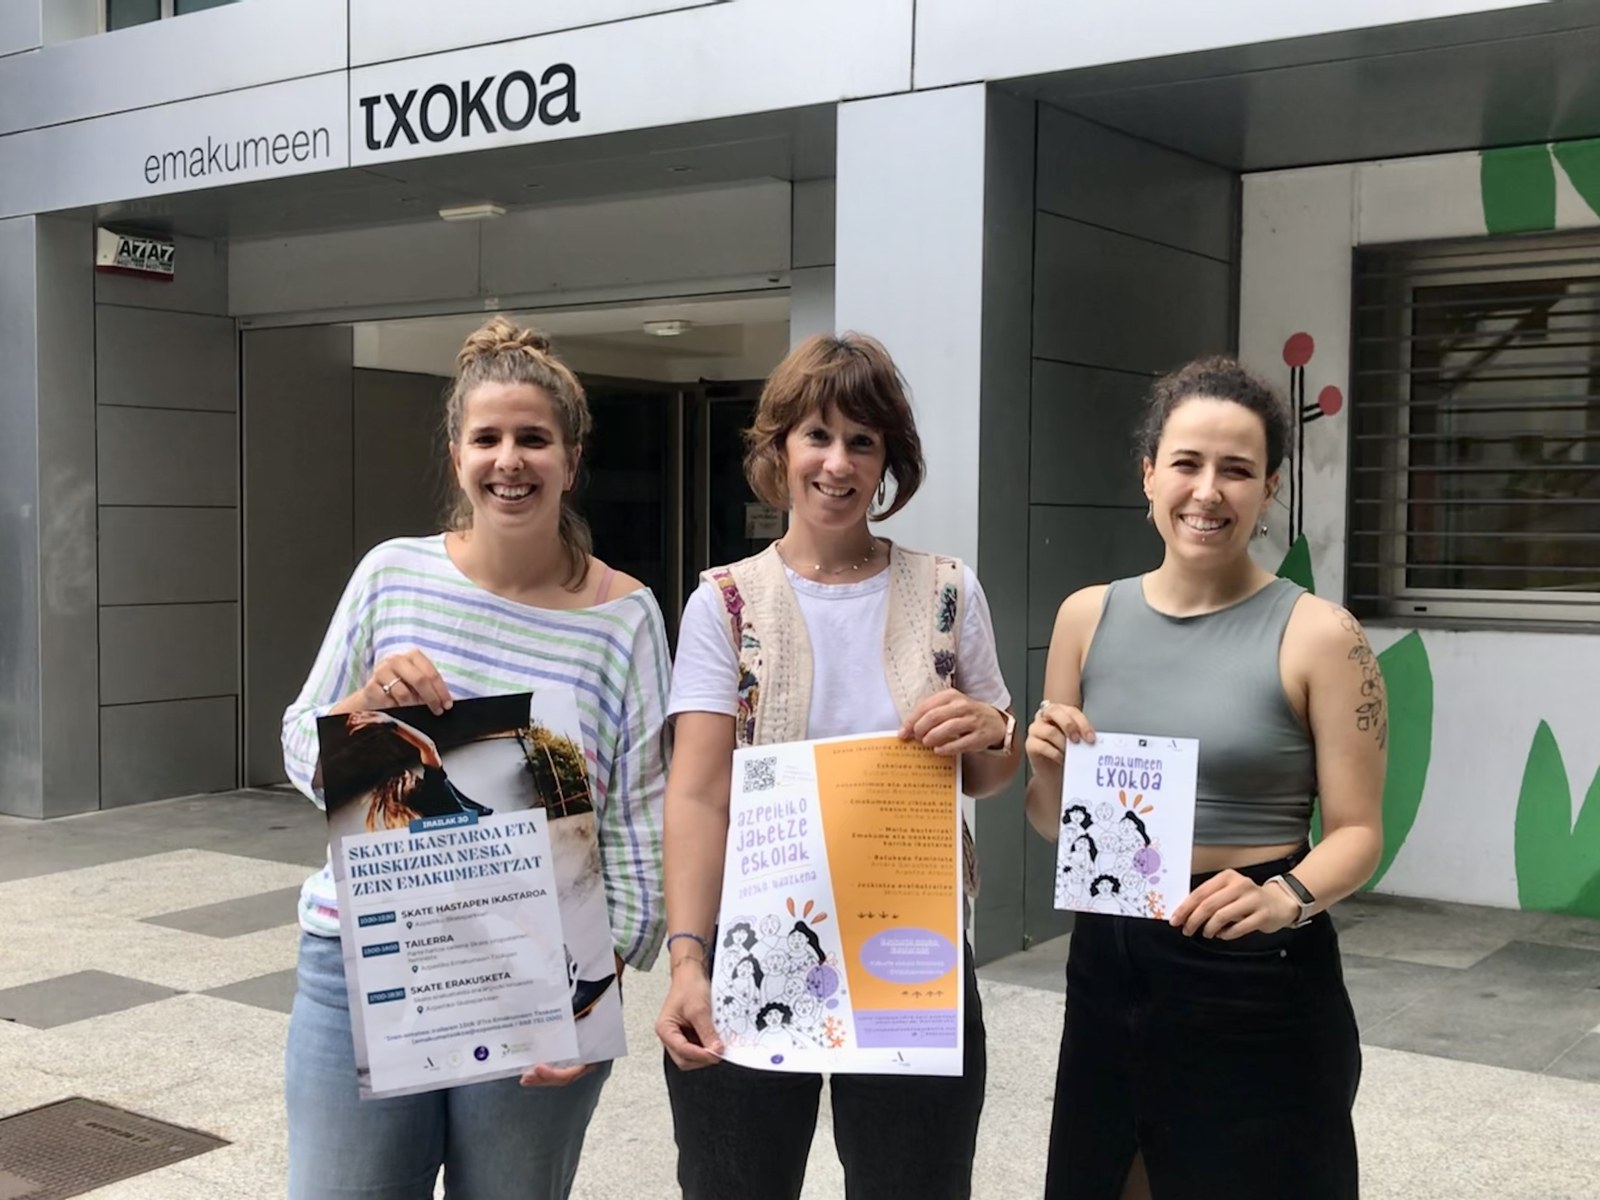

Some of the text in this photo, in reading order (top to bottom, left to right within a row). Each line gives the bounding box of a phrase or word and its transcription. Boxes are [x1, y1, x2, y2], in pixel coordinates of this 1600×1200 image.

[145, 63, 580, 184] emakumeen txokoa
[423, 815, 469, 828] IRAILAK 30
[349, 821, 537, 860] SKATE IKASTAROA ETA
[350, 843, 512, 878] IKUSKIZUNA NESKA
[352, 855, 542, 896] ZEIN EMAKUMEENTZAT
[401, 889, 547, 919] SKATE HASTAPEN IKASTAROA
[405, 935, 454, 949] TAILERRA
[410, 982, 442, 995] SKATE
[445, 972, 512, 989] ERAKUSKETA
